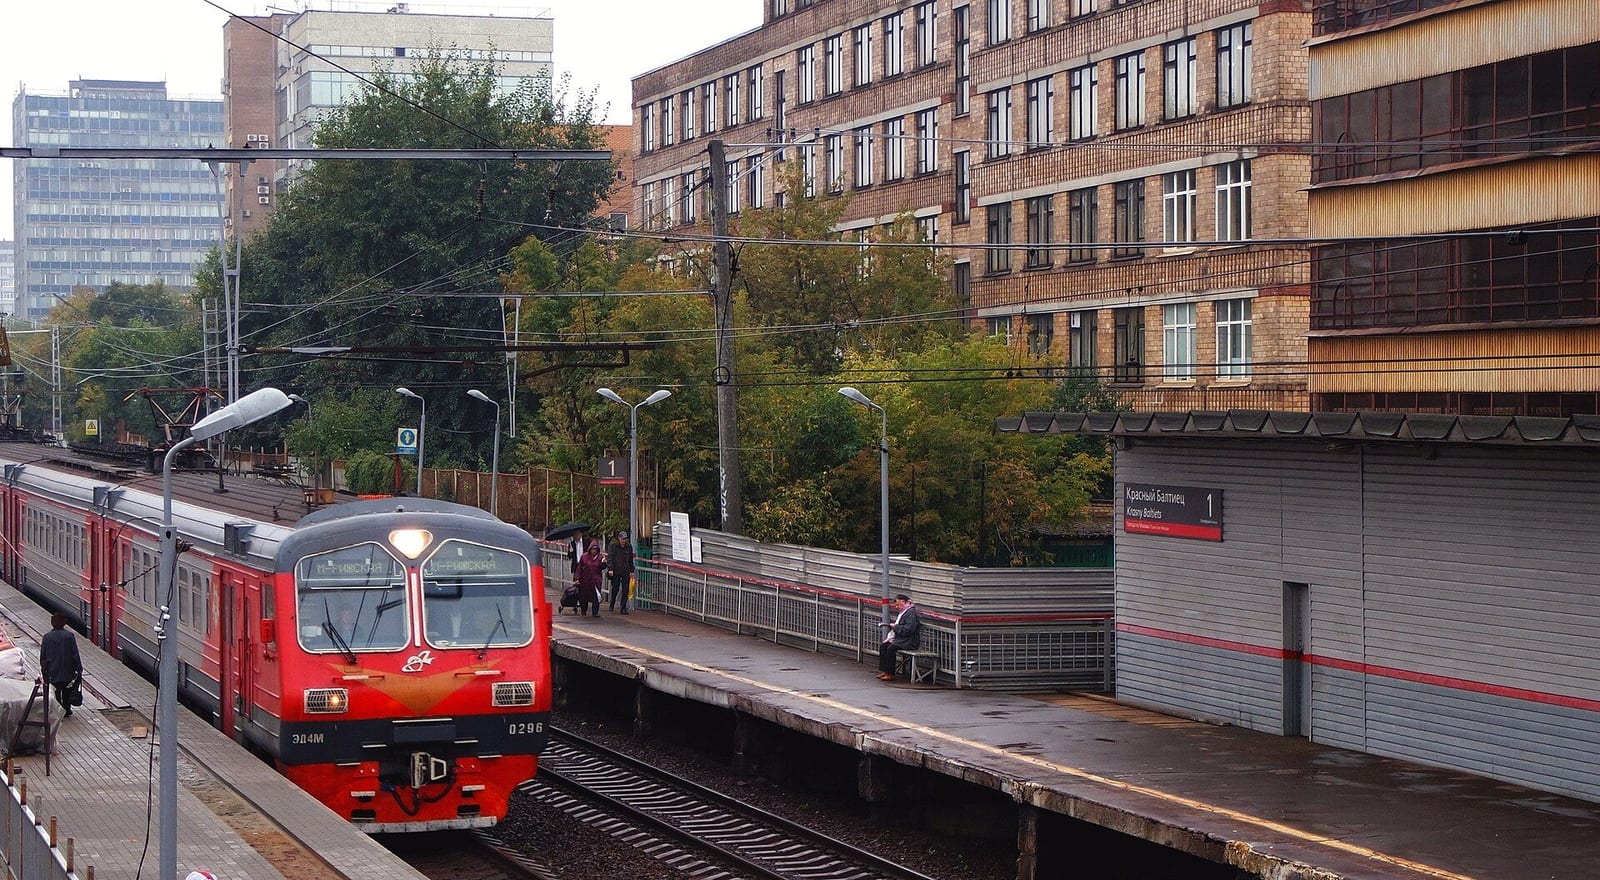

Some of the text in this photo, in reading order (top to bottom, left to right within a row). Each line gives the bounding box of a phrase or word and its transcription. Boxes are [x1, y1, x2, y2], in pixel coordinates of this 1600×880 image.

[608, 460, 615, 476] 1
[1126, 487, 1185, 506] Красный Балтиец
[1127, 506, 1143, 519] Krasny
[1206, 493, 1212, 518] 1
[509, 722, 543, 735] 0296
[292, 733, 324, 744] ЭД4М
